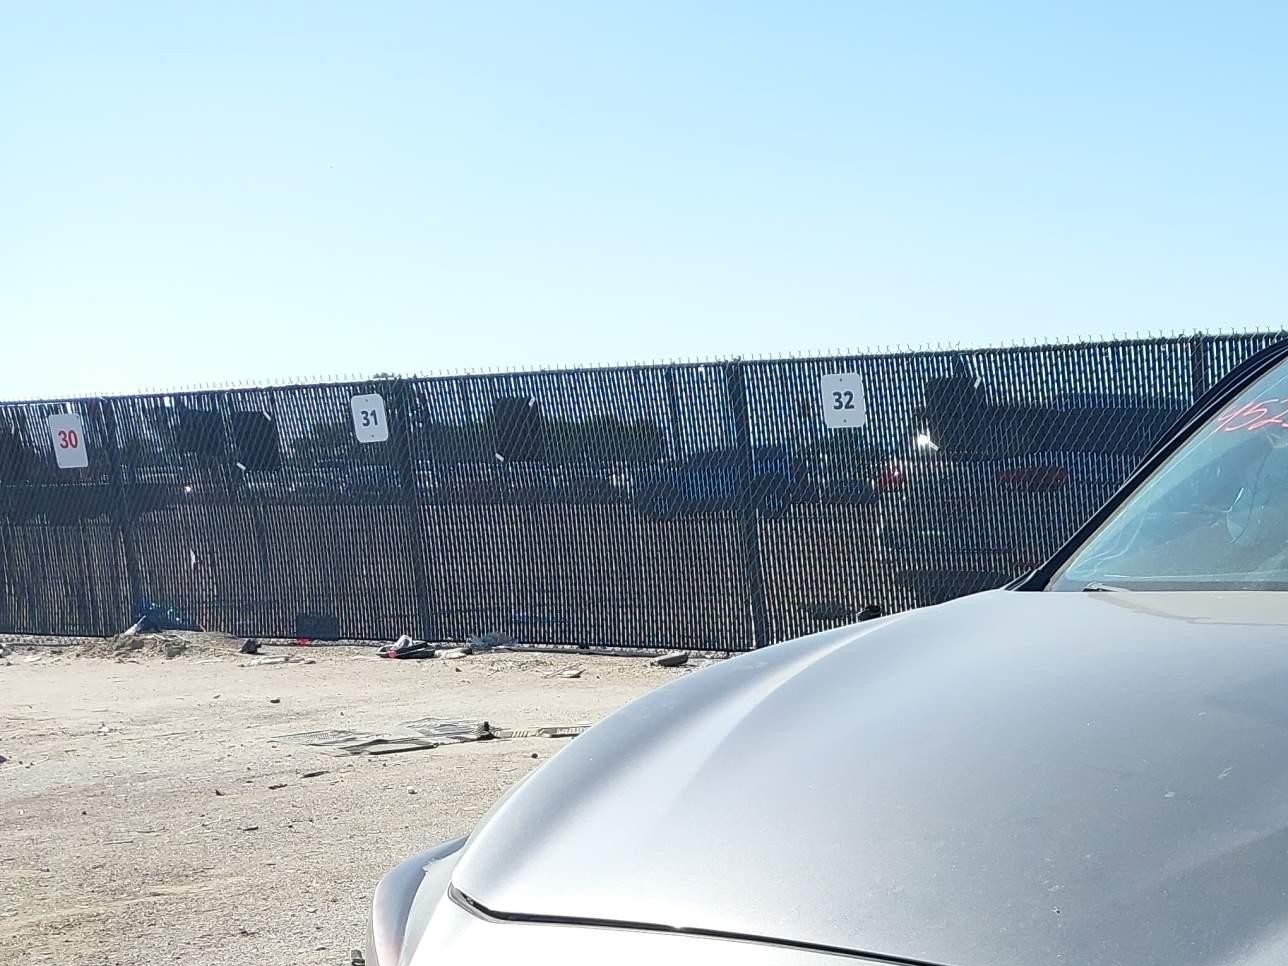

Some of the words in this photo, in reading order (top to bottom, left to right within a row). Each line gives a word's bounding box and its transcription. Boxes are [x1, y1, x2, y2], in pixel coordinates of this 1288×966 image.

[832, 391, 855, 410] 32
[360, 409, 378, 427] 31
[57, 429, 79, 449] 30
